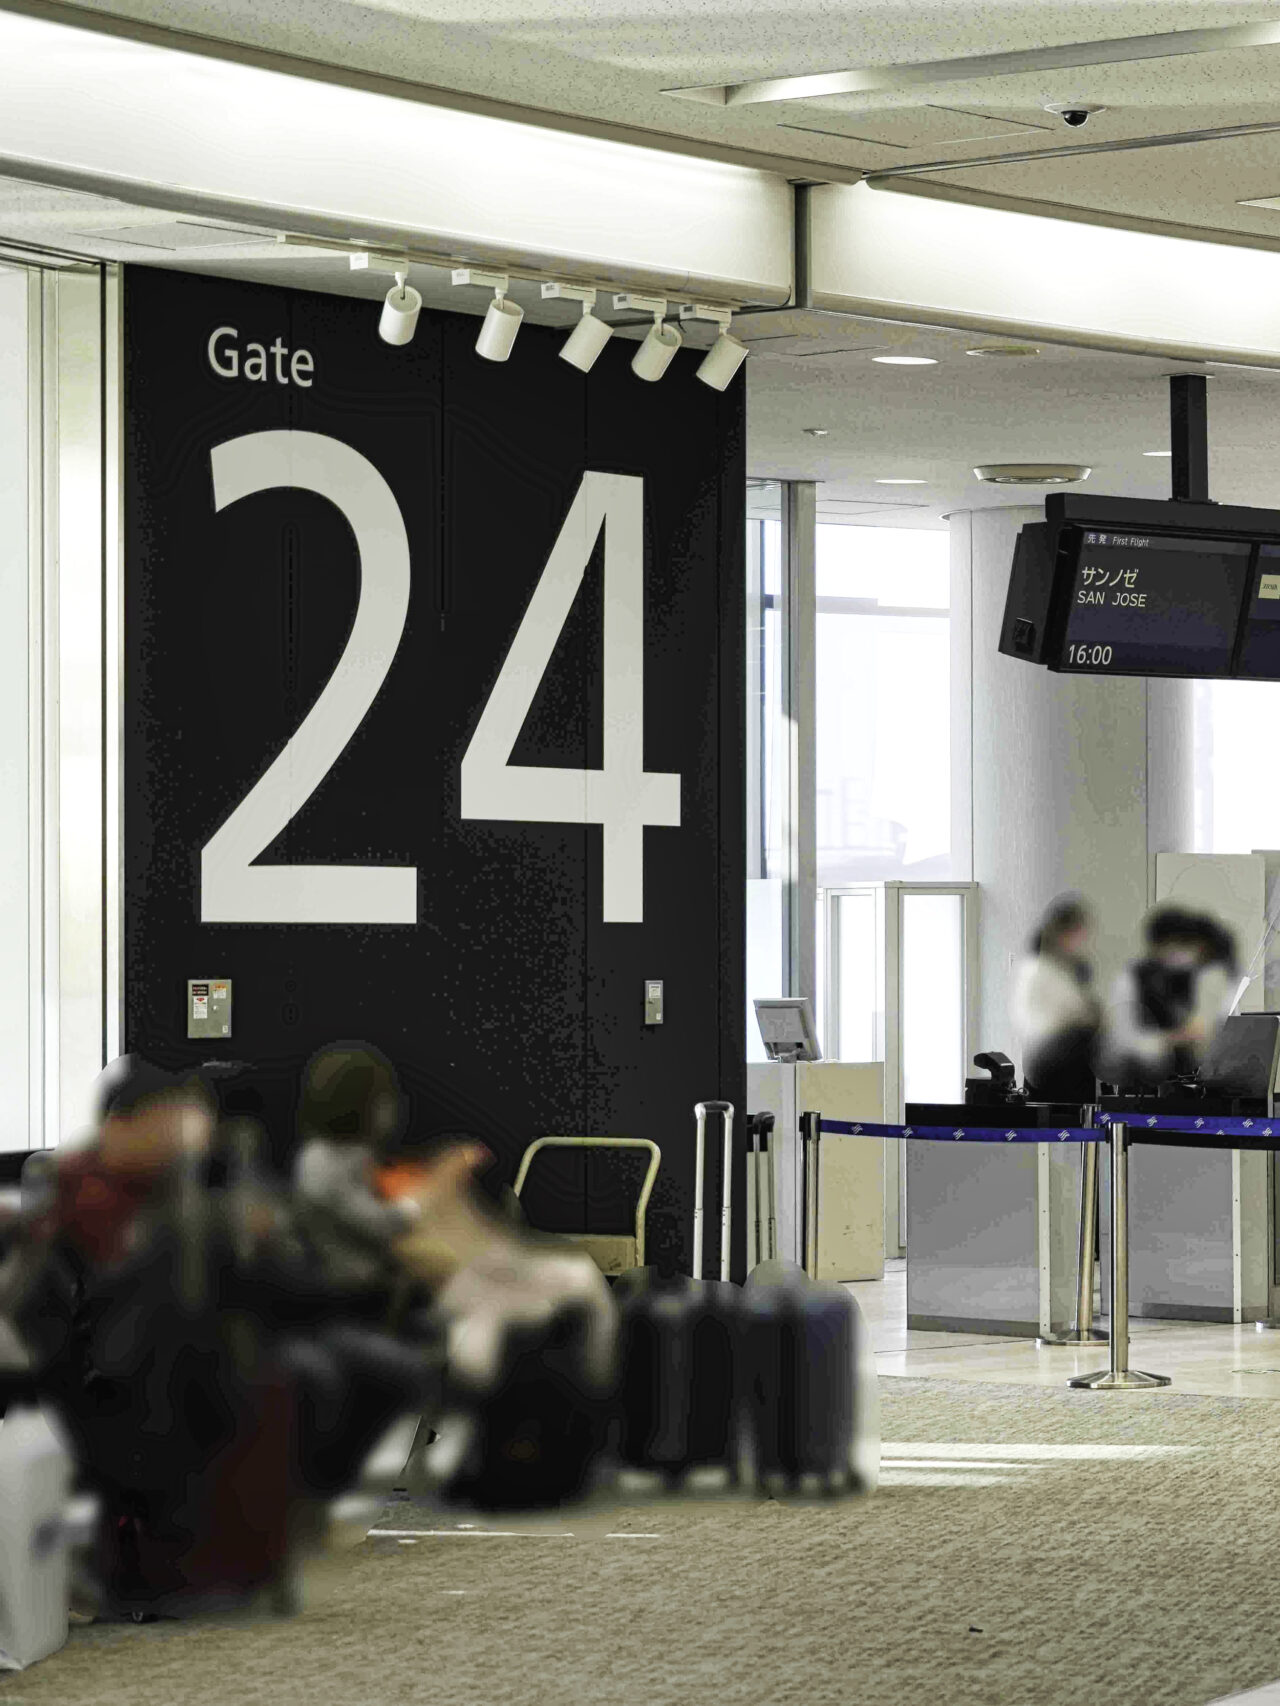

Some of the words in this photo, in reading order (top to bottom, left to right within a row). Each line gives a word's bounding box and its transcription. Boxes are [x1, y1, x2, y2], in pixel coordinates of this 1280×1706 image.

[207, 326, 315, 388] Gate
[1112, 536, 1128, 546] First
[1130, 537, 1150, 547] Flight
[1081, 566, 1139, 588] サンノゼ
[1077, 590, 1106, 605] SAN
[1111, 593, 1148, 608] JOSE
[1068, 644, 1113, 665] 16:00
[200, 429, 682, 924] 24
